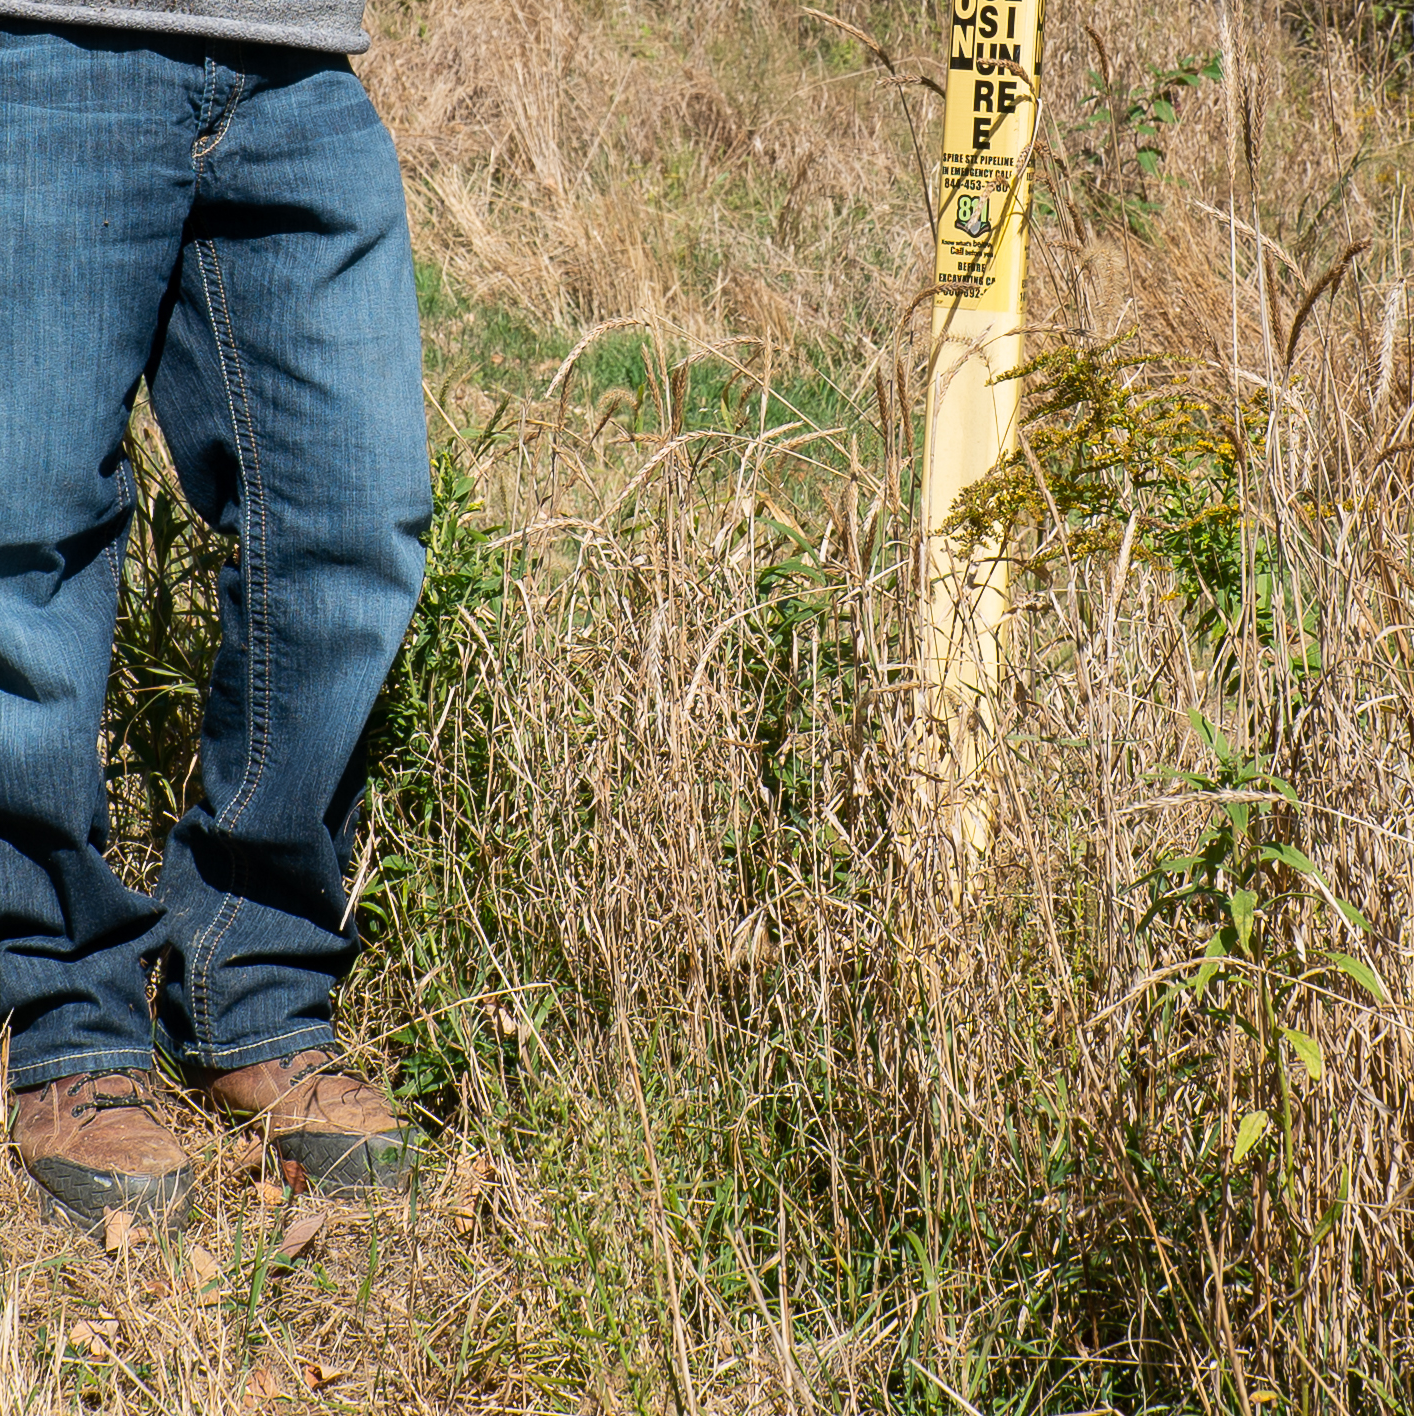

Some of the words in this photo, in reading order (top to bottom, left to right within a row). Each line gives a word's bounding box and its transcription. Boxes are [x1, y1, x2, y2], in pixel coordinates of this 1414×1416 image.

[943, 152, 963, 163] SPIRE
[980, 155, 1014, 167] PIPELINE
[951, 167, 994, 179] EMERGENCY
[957, 261, 986, 273] BEFORE
[939, 272, 984, 286] EXCAVATING
